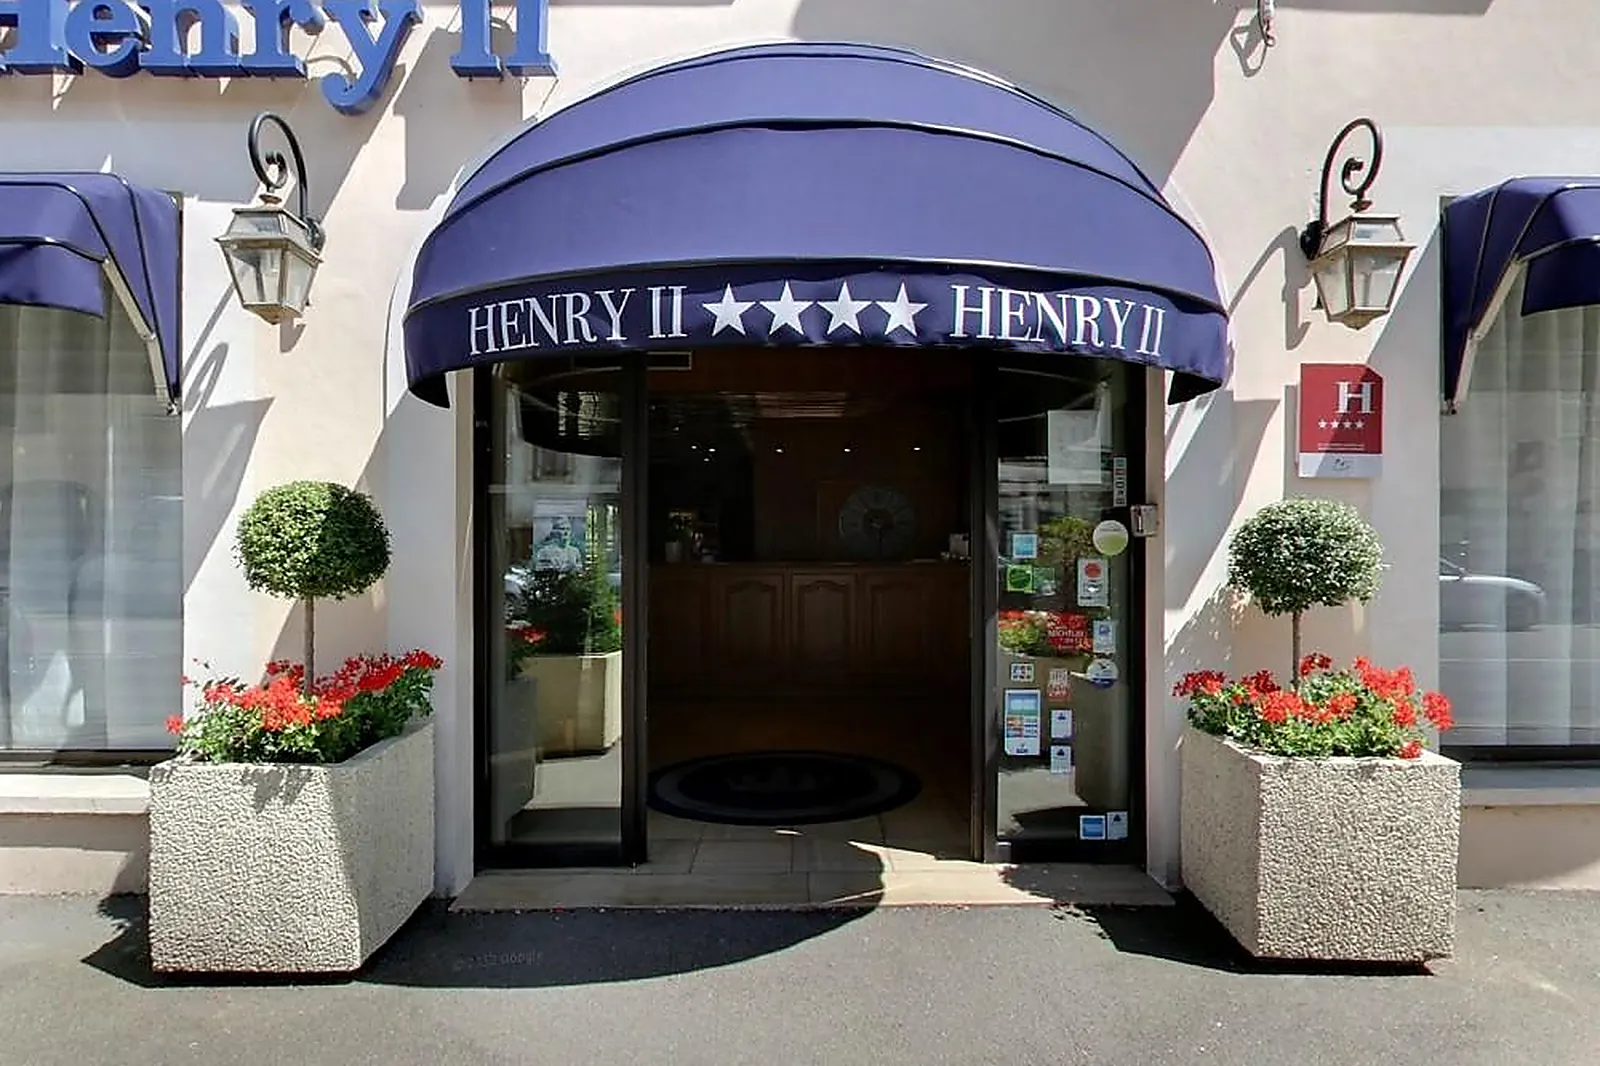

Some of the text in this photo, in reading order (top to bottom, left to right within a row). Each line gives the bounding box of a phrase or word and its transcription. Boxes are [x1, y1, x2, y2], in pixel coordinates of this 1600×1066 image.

[467, 284, 1166, 357] HENRY II HENRY II
[1333, 381, 1375, 414] H
